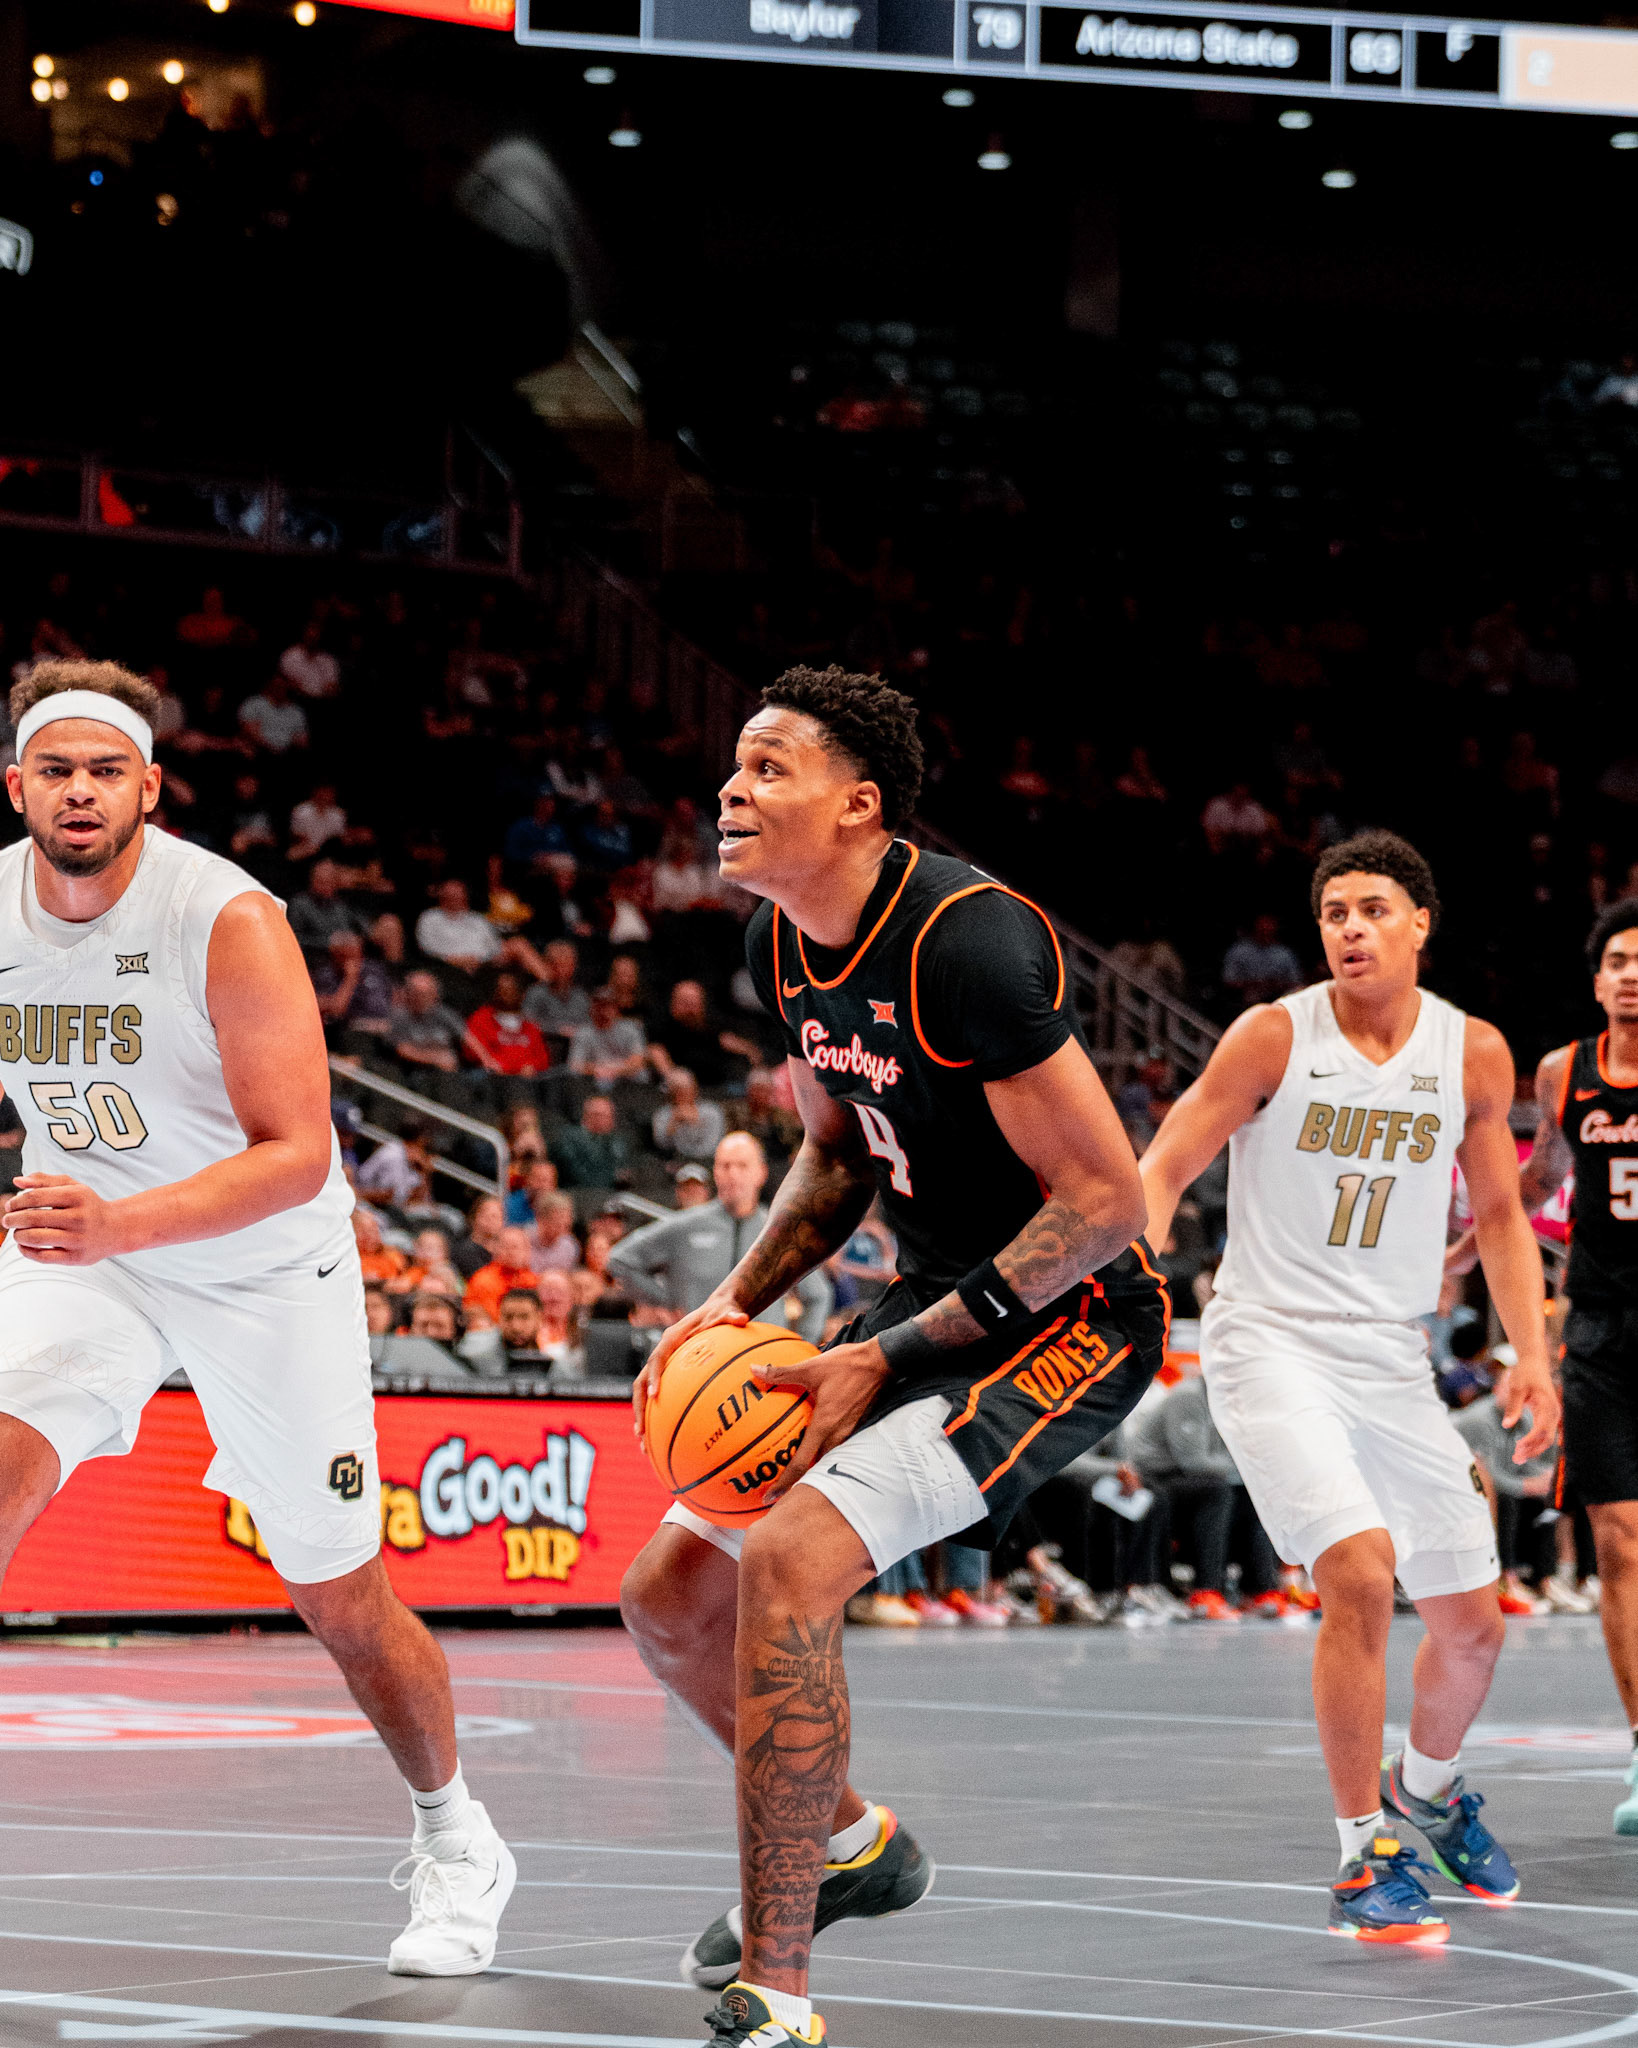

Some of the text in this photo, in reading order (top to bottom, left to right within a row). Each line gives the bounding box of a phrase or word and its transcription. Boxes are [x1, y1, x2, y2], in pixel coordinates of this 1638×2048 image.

[750, 0, 861, 43] Baylor
[973, 7, 1022, 49] 79
[1076, 15, 1299, 68] Arizona State
[0, 1004, 142, 1064] BUFFS
[801, 1019, 903, 1094] Cowboys
[29, 1081, 149, 1151] 50
[1296, 1102, 1441, 1163] BUFFS
[852, 1101, 913, 1198] 4
[1327, 1173, 1396, 1248] 11
[420, 1430, 596, 1536] Good!
[503, 1526, 581, 1581] DIP
